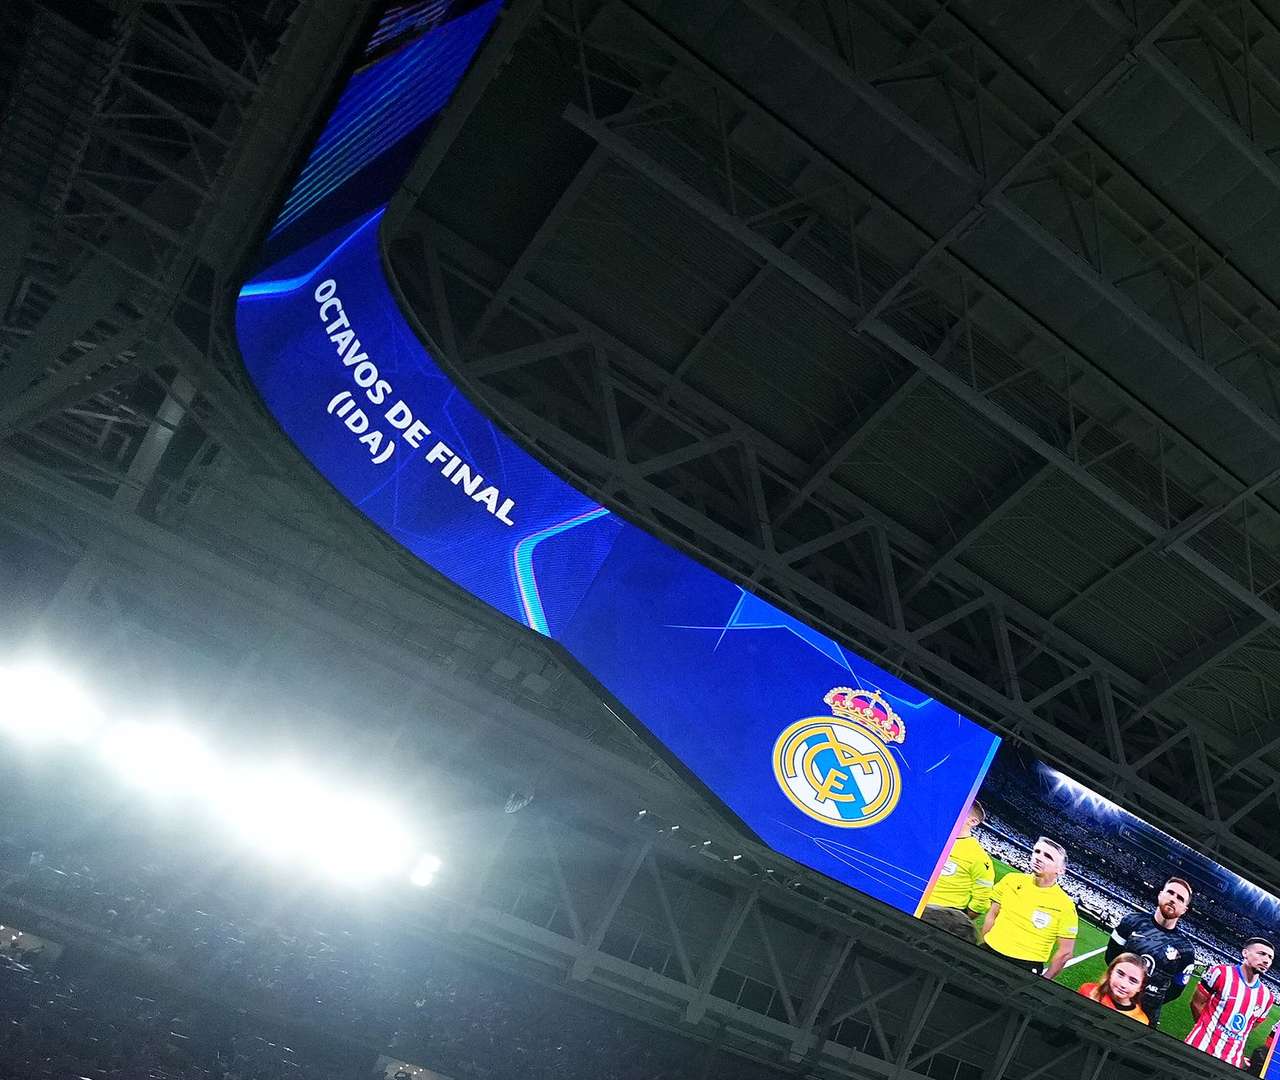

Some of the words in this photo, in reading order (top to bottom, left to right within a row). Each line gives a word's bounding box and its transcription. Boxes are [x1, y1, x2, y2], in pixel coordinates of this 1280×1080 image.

[314, 279, 392, 405] OCTAVOS
[385, 400, 431, 449] DE
[426, 441, 516, 527] FINAL
[327, 391, 395, 465] (IDA)
